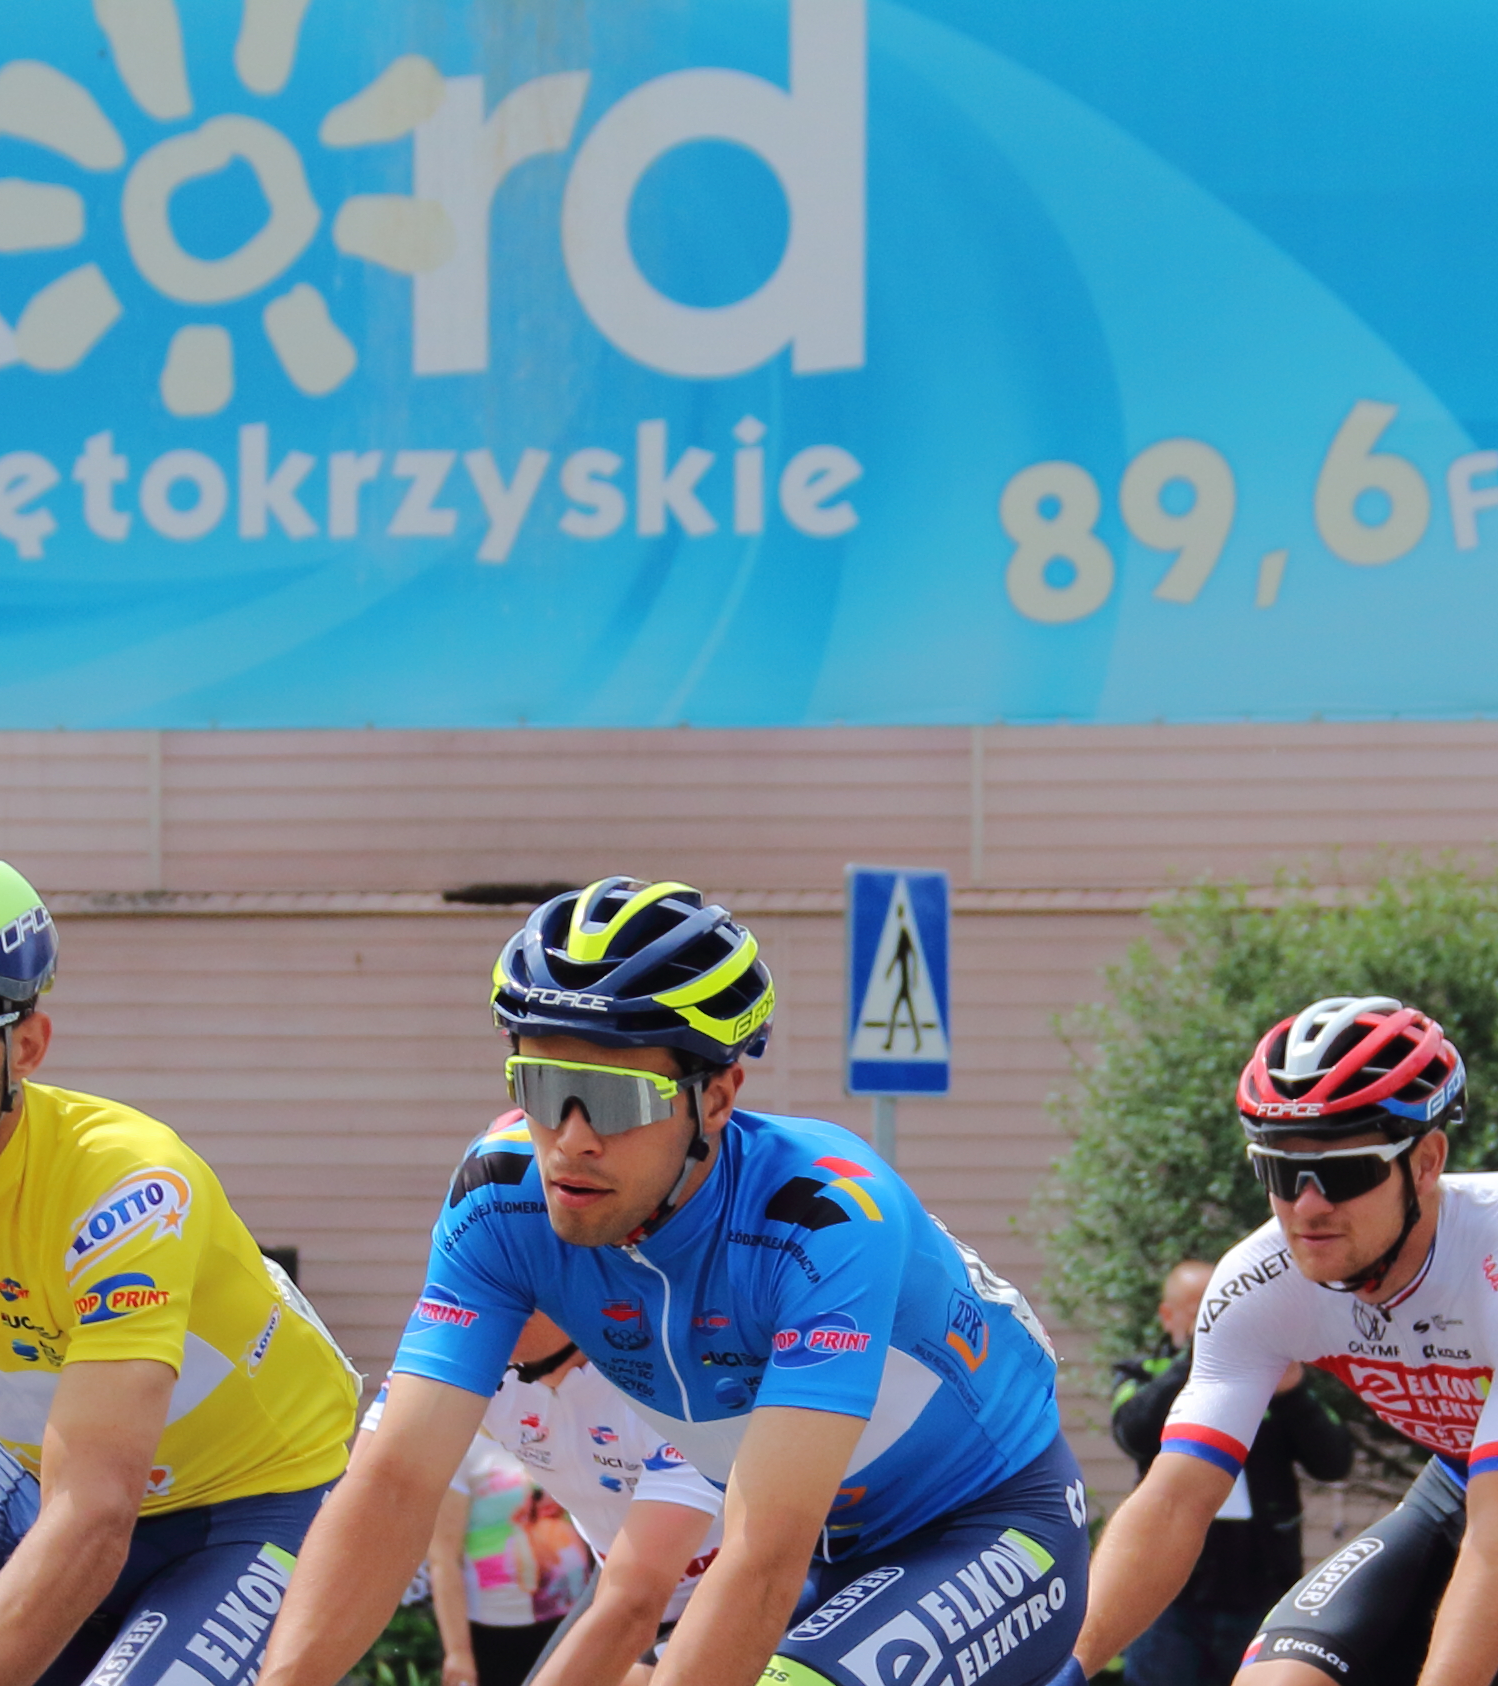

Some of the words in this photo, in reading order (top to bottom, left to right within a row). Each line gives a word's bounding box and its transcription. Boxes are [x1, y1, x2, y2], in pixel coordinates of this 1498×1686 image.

[1000, 398, 1432, 624] 89,6
[524, 987, 614, 1012] FORCE
[1257, 1102, 1323, 1117] FORCE
[72, 1182, 165, 1256] LOTTO
[112, 1290, 170, 1309] PRINT
[421, 1301, 480, 1328] PRINT
[809, 1330, 871, 1353] PRINT
[951, 1299, 983, 1348] ZPK
[1418, 1397, 1483, 1421] ELEKT
[917, 1532, 1046, 1647] ELKOV
[1304, 1542, 1376, 1605] KASPER
[800, 1567, 898, 1640] KASPER
